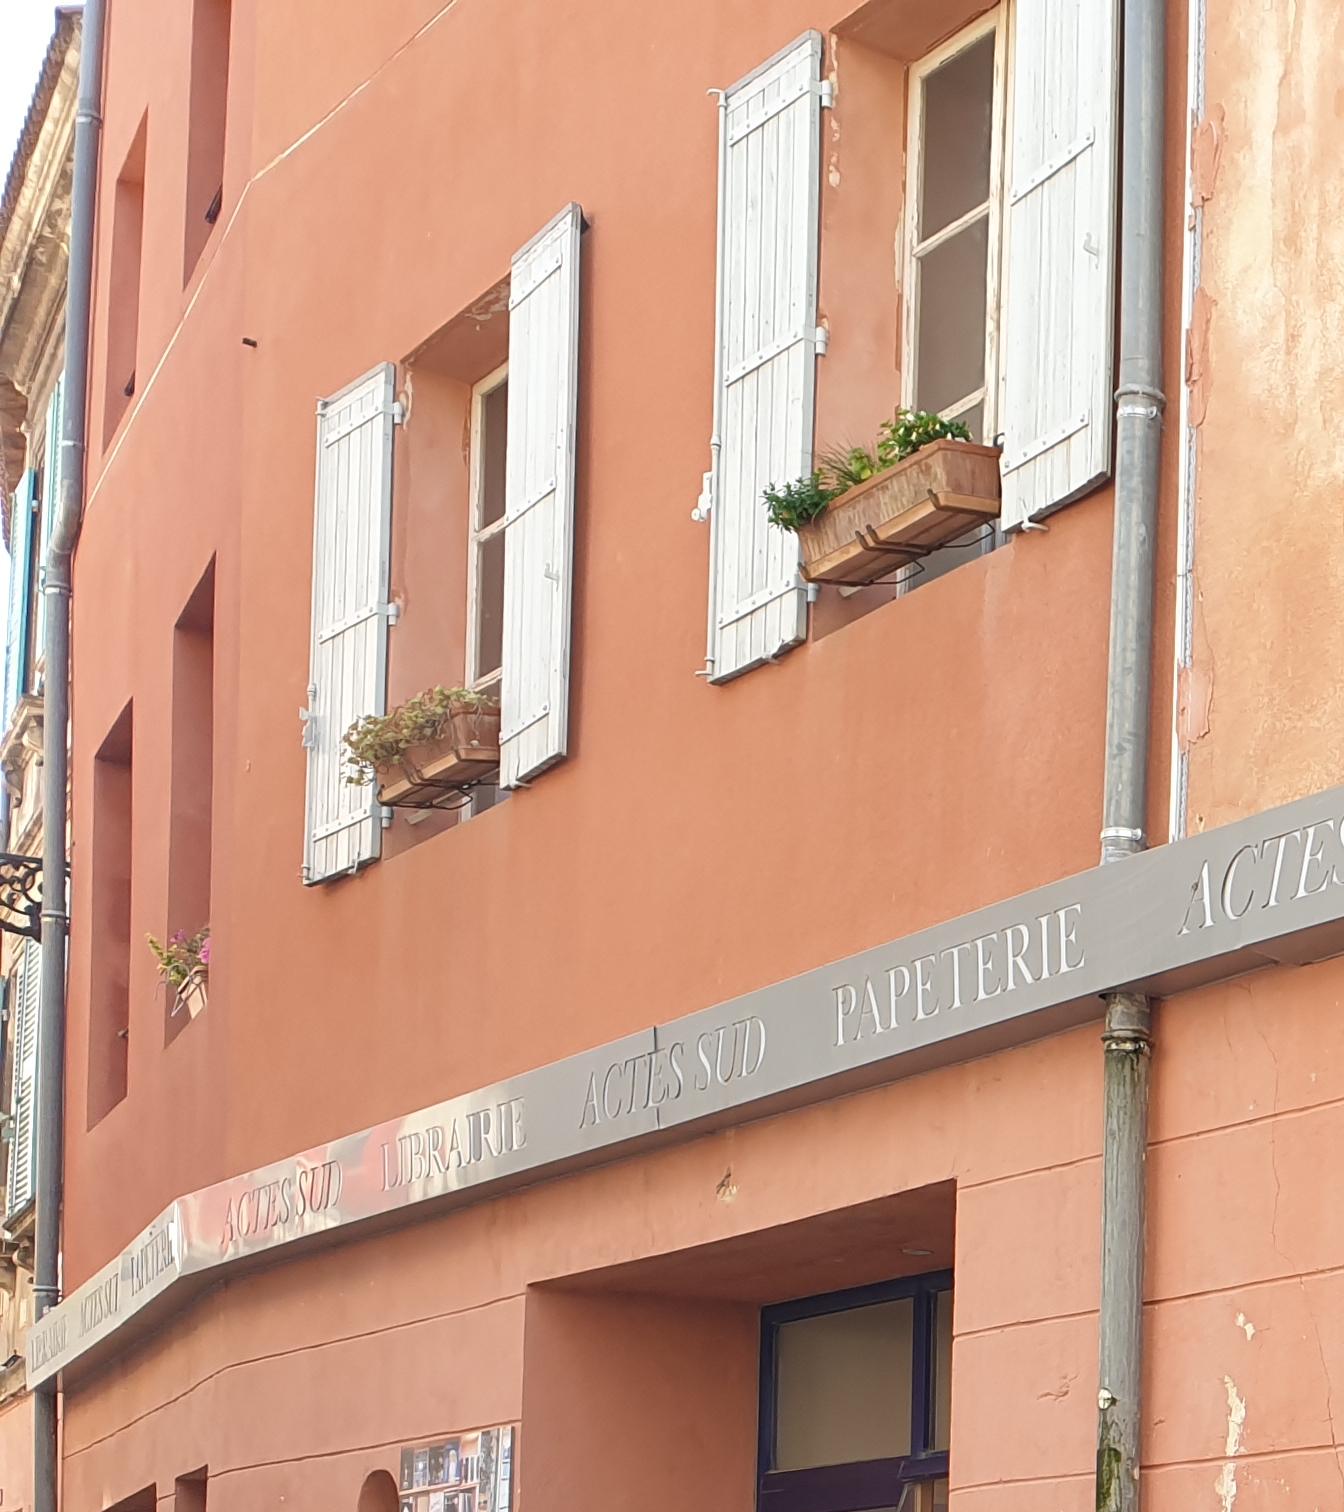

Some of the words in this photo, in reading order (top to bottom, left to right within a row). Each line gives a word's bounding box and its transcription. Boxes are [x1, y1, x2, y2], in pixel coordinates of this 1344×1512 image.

[831, 902, 1086, 1048] PAPETERIE
[579, 1041, 685, 1130] ACTES
[694, 1014, 767, 1091] SUD
[380, 1096, 528, 1192] LIBRAIRIE
[221, 1176, 293, 1246] ACTES
[298, 1158, 344, 1217] SUD
